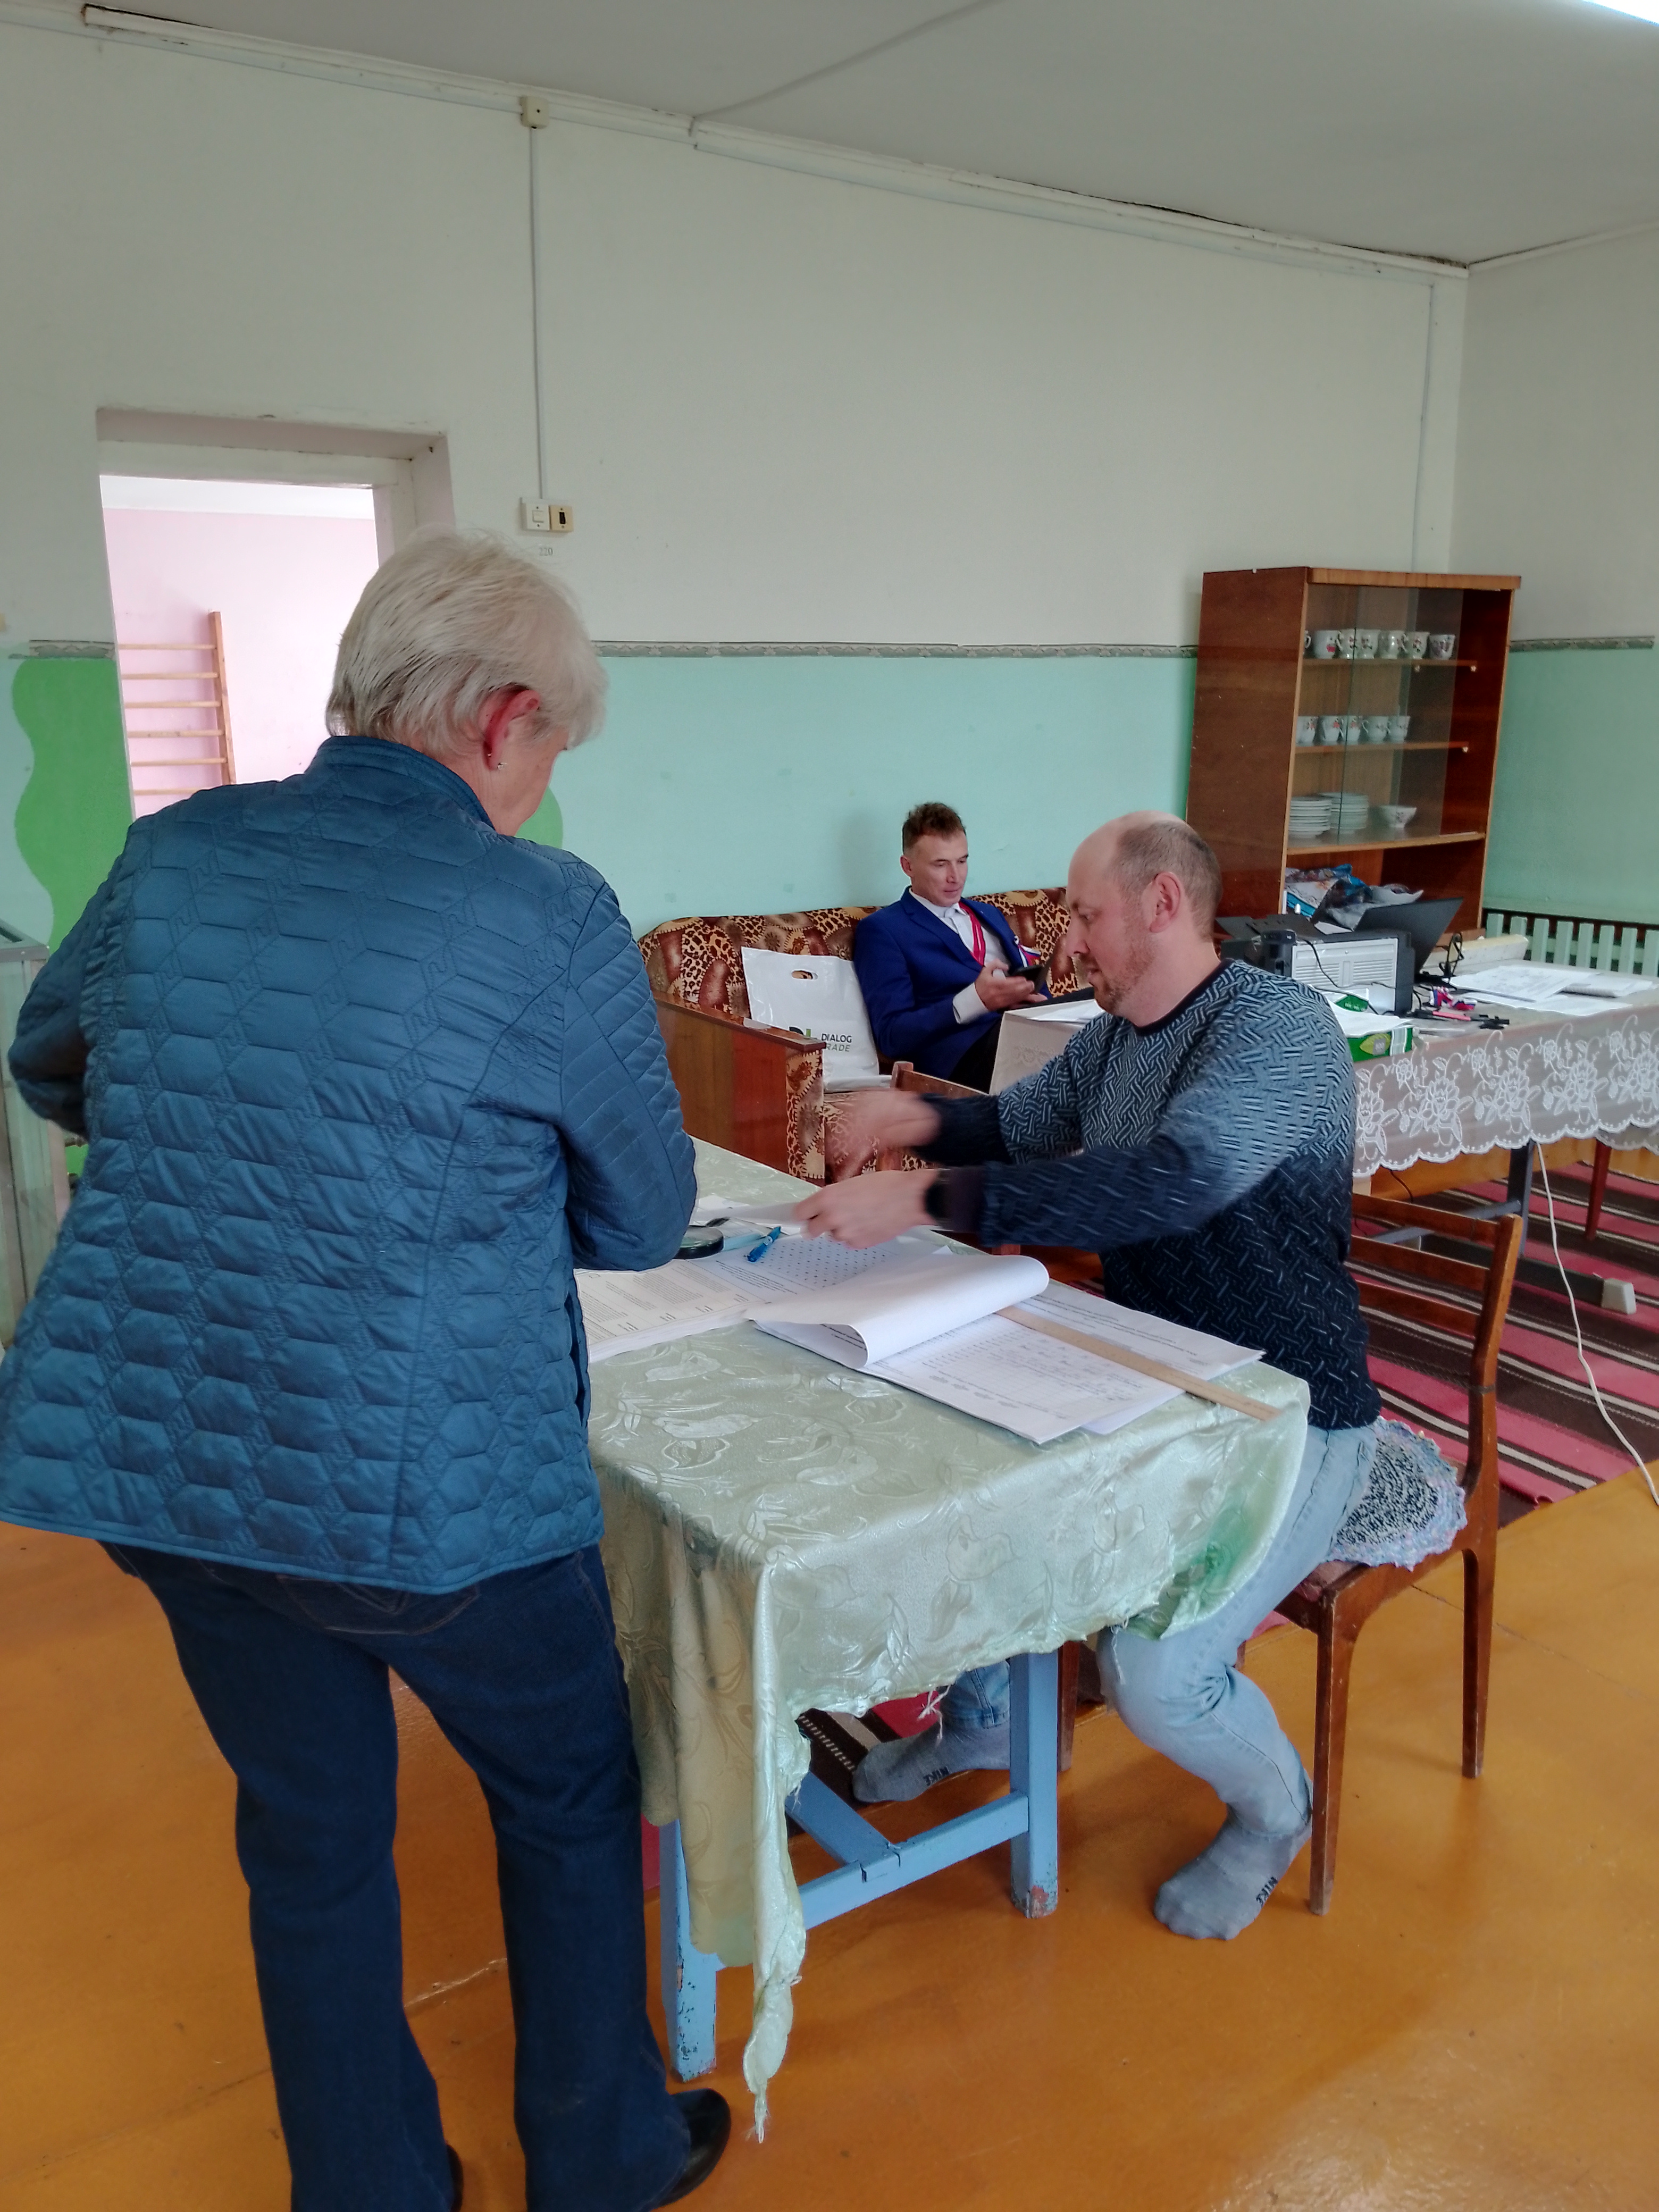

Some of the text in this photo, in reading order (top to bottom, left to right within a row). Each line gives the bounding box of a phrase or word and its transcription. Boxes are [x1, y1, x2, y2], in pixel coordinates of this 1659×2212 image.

[539, 547, 554, 556] 220
[822, 1033, 852, 1043] DIALOG
[826, 1043, 851, 1052] RADE
[923, 1766, 950, 1787] NIKE
[1256, 1876, 1278, 1908] NIKE
